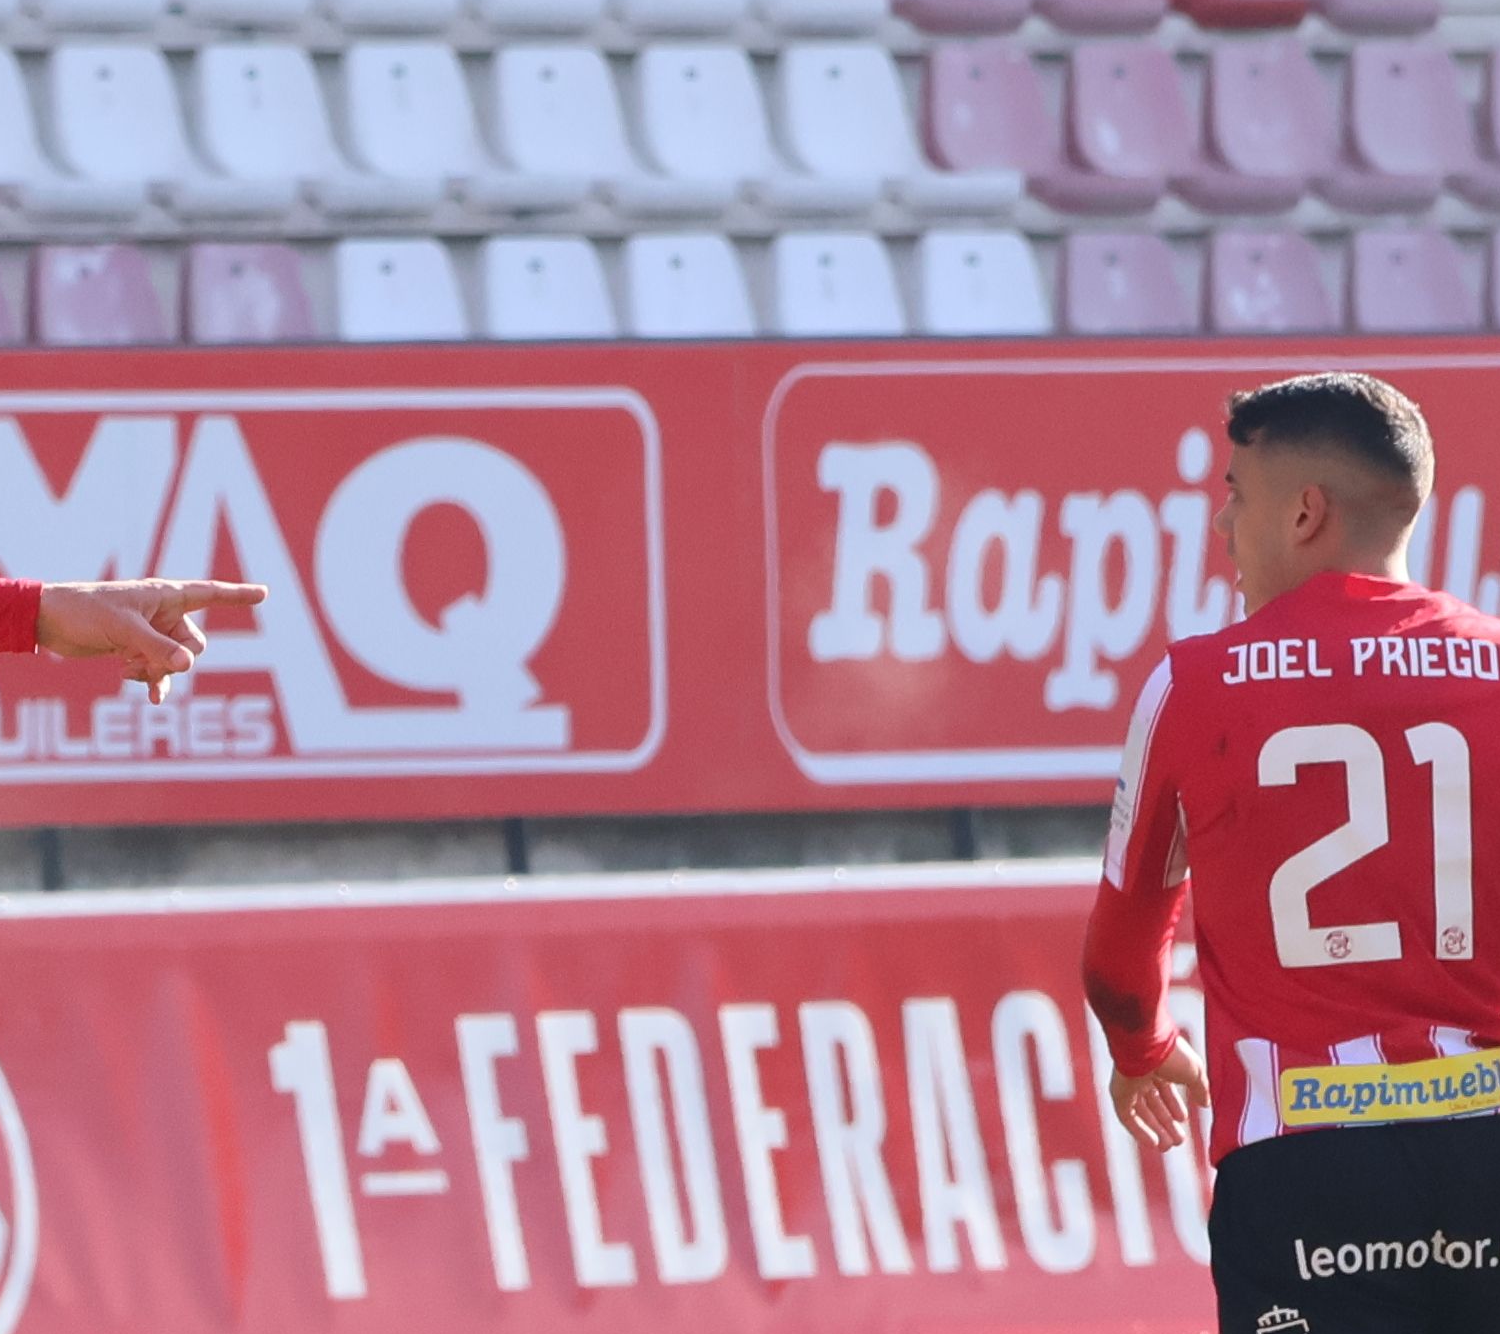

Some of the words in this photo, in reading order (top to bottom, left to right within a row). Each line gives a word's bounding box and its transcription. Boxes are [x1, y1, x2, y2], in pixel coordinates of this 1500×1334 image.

[1222, 639, 1332, 685] JOEL
[1350, 637, 1499, 681] PRIEGO
[1257, 723, 1474, 968] 21
[454, 943, 1213, 1291] FEDERACI
